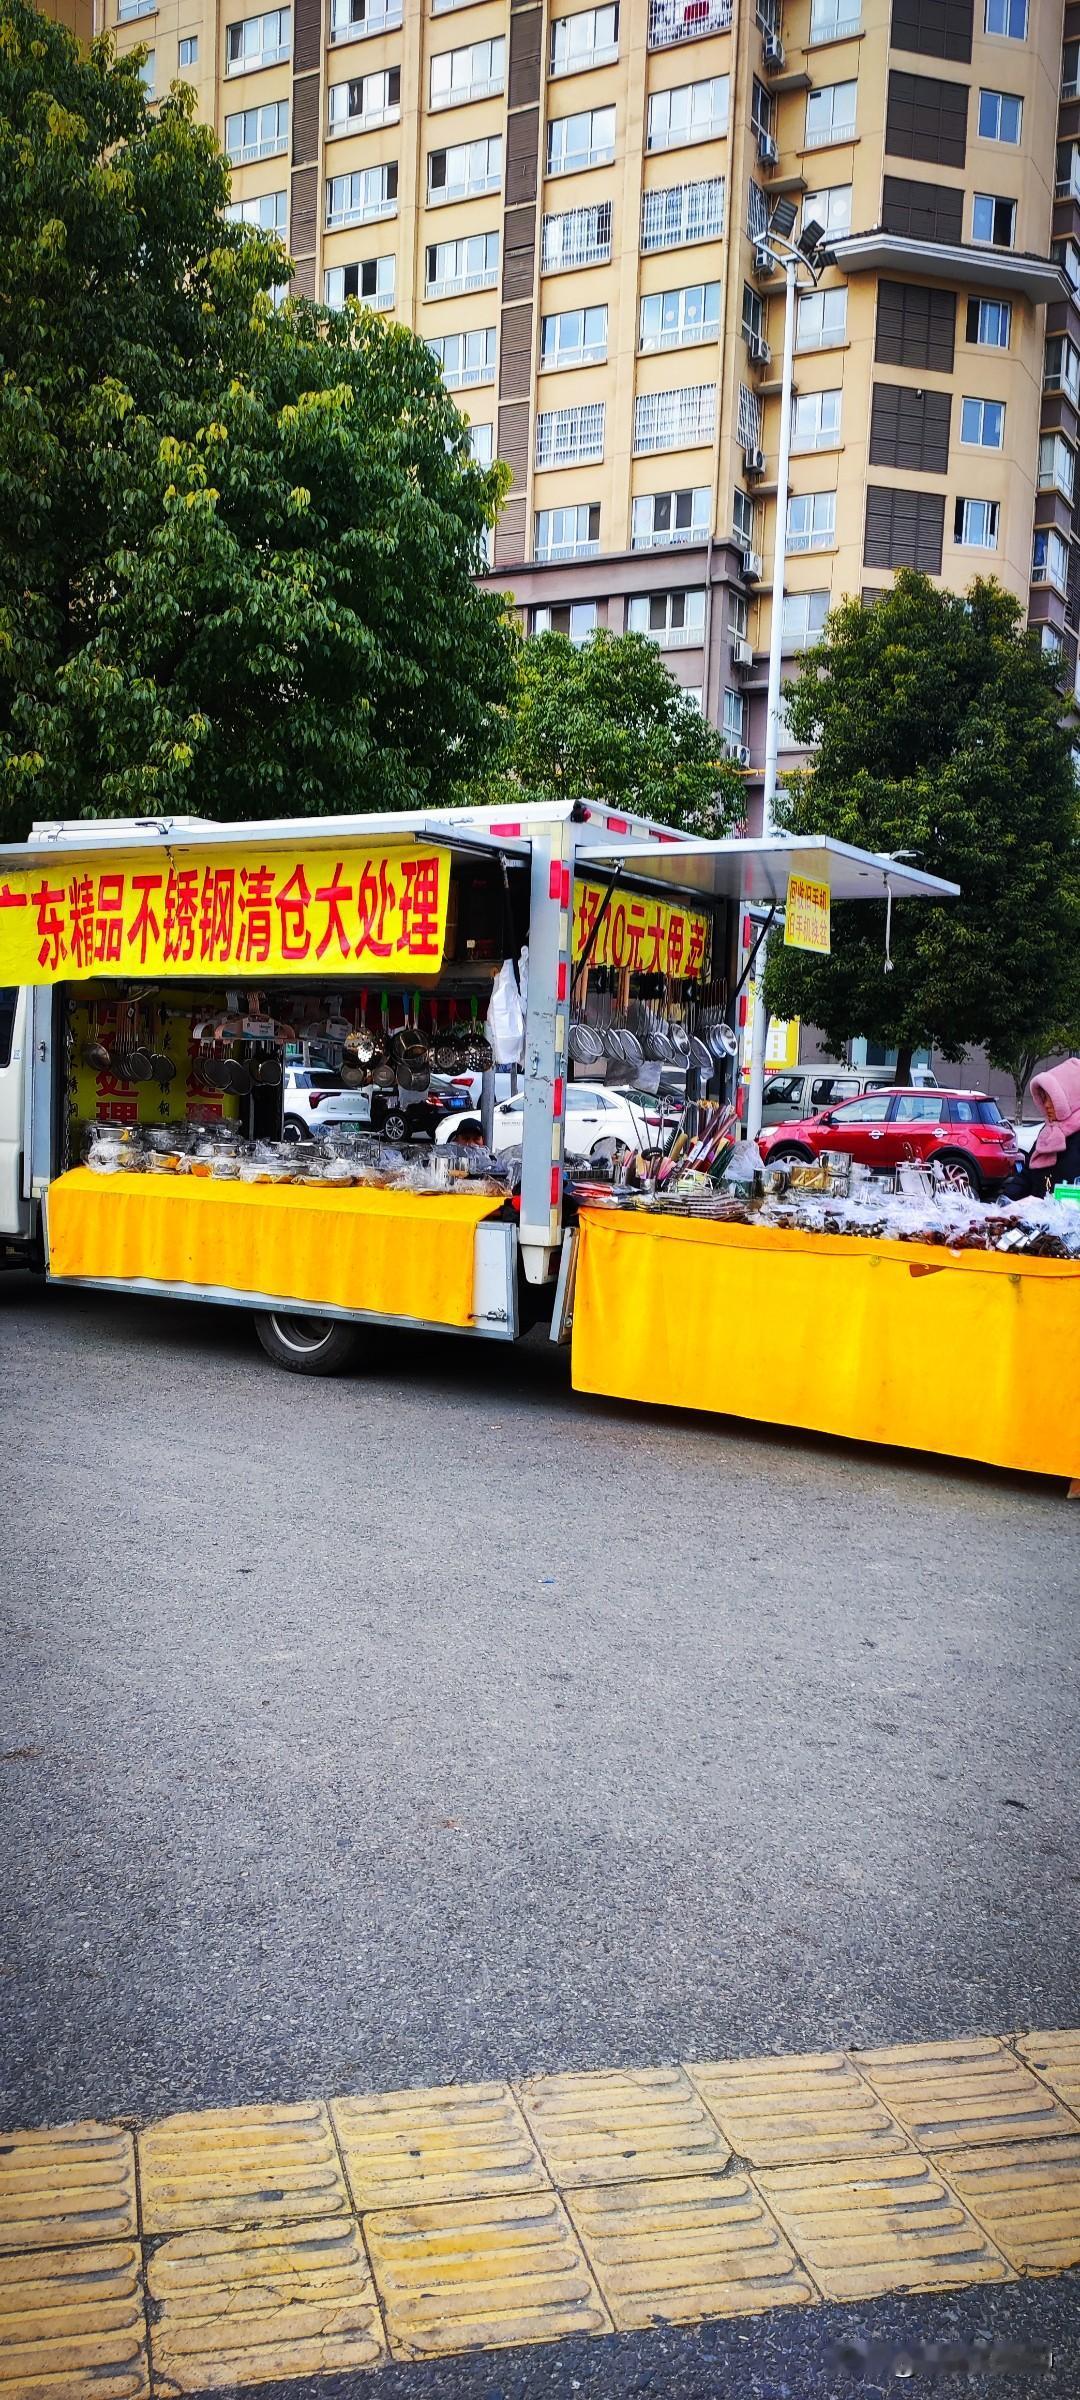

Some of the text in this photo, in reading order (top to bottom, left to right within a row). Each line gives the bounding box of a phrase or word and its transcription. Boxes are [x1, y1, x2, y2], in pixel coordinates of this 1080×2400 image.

[572, 884, 704, 976] 场10元大甩卖
